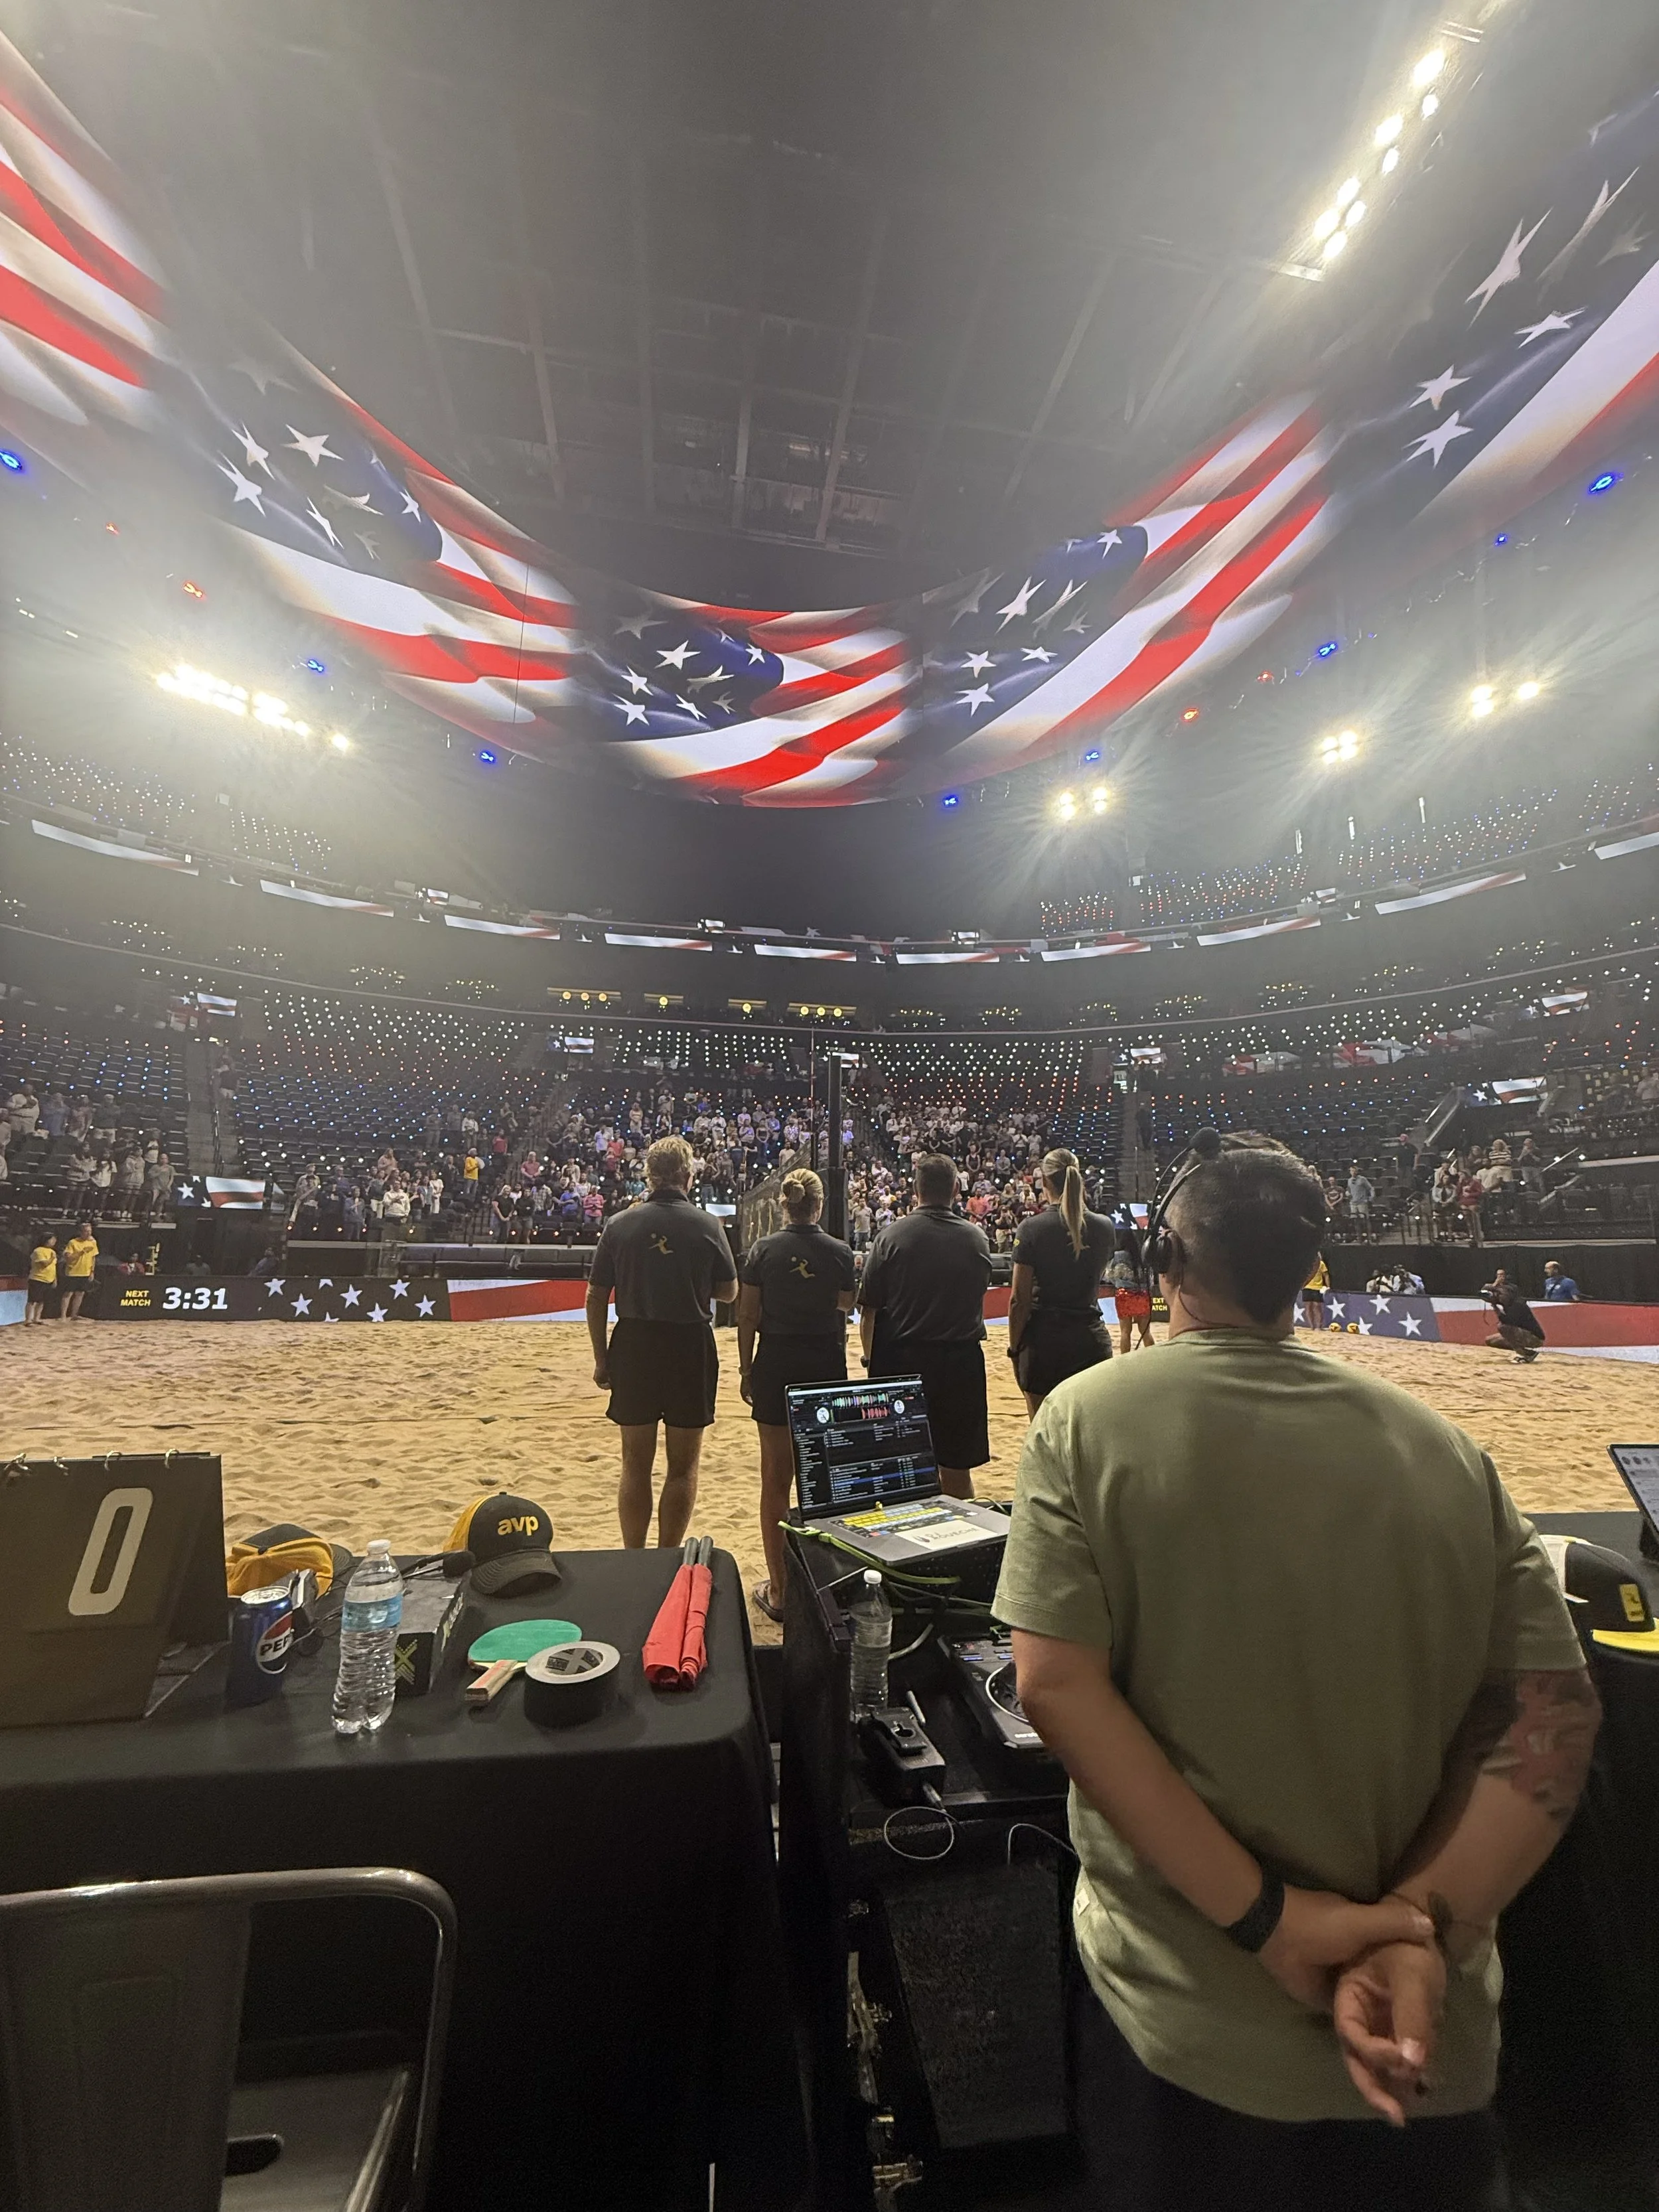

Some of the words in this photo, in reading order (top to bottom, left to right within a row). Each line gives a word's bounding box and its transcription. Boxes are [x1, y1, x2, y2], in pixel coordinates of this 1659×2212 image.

[163, 1287, 228, 1309] 3:31
[498, 1516, 538, 1536] avp
[68, 1488, 153, 1616] 0
[259, 1633, 291, 1656] PEP
